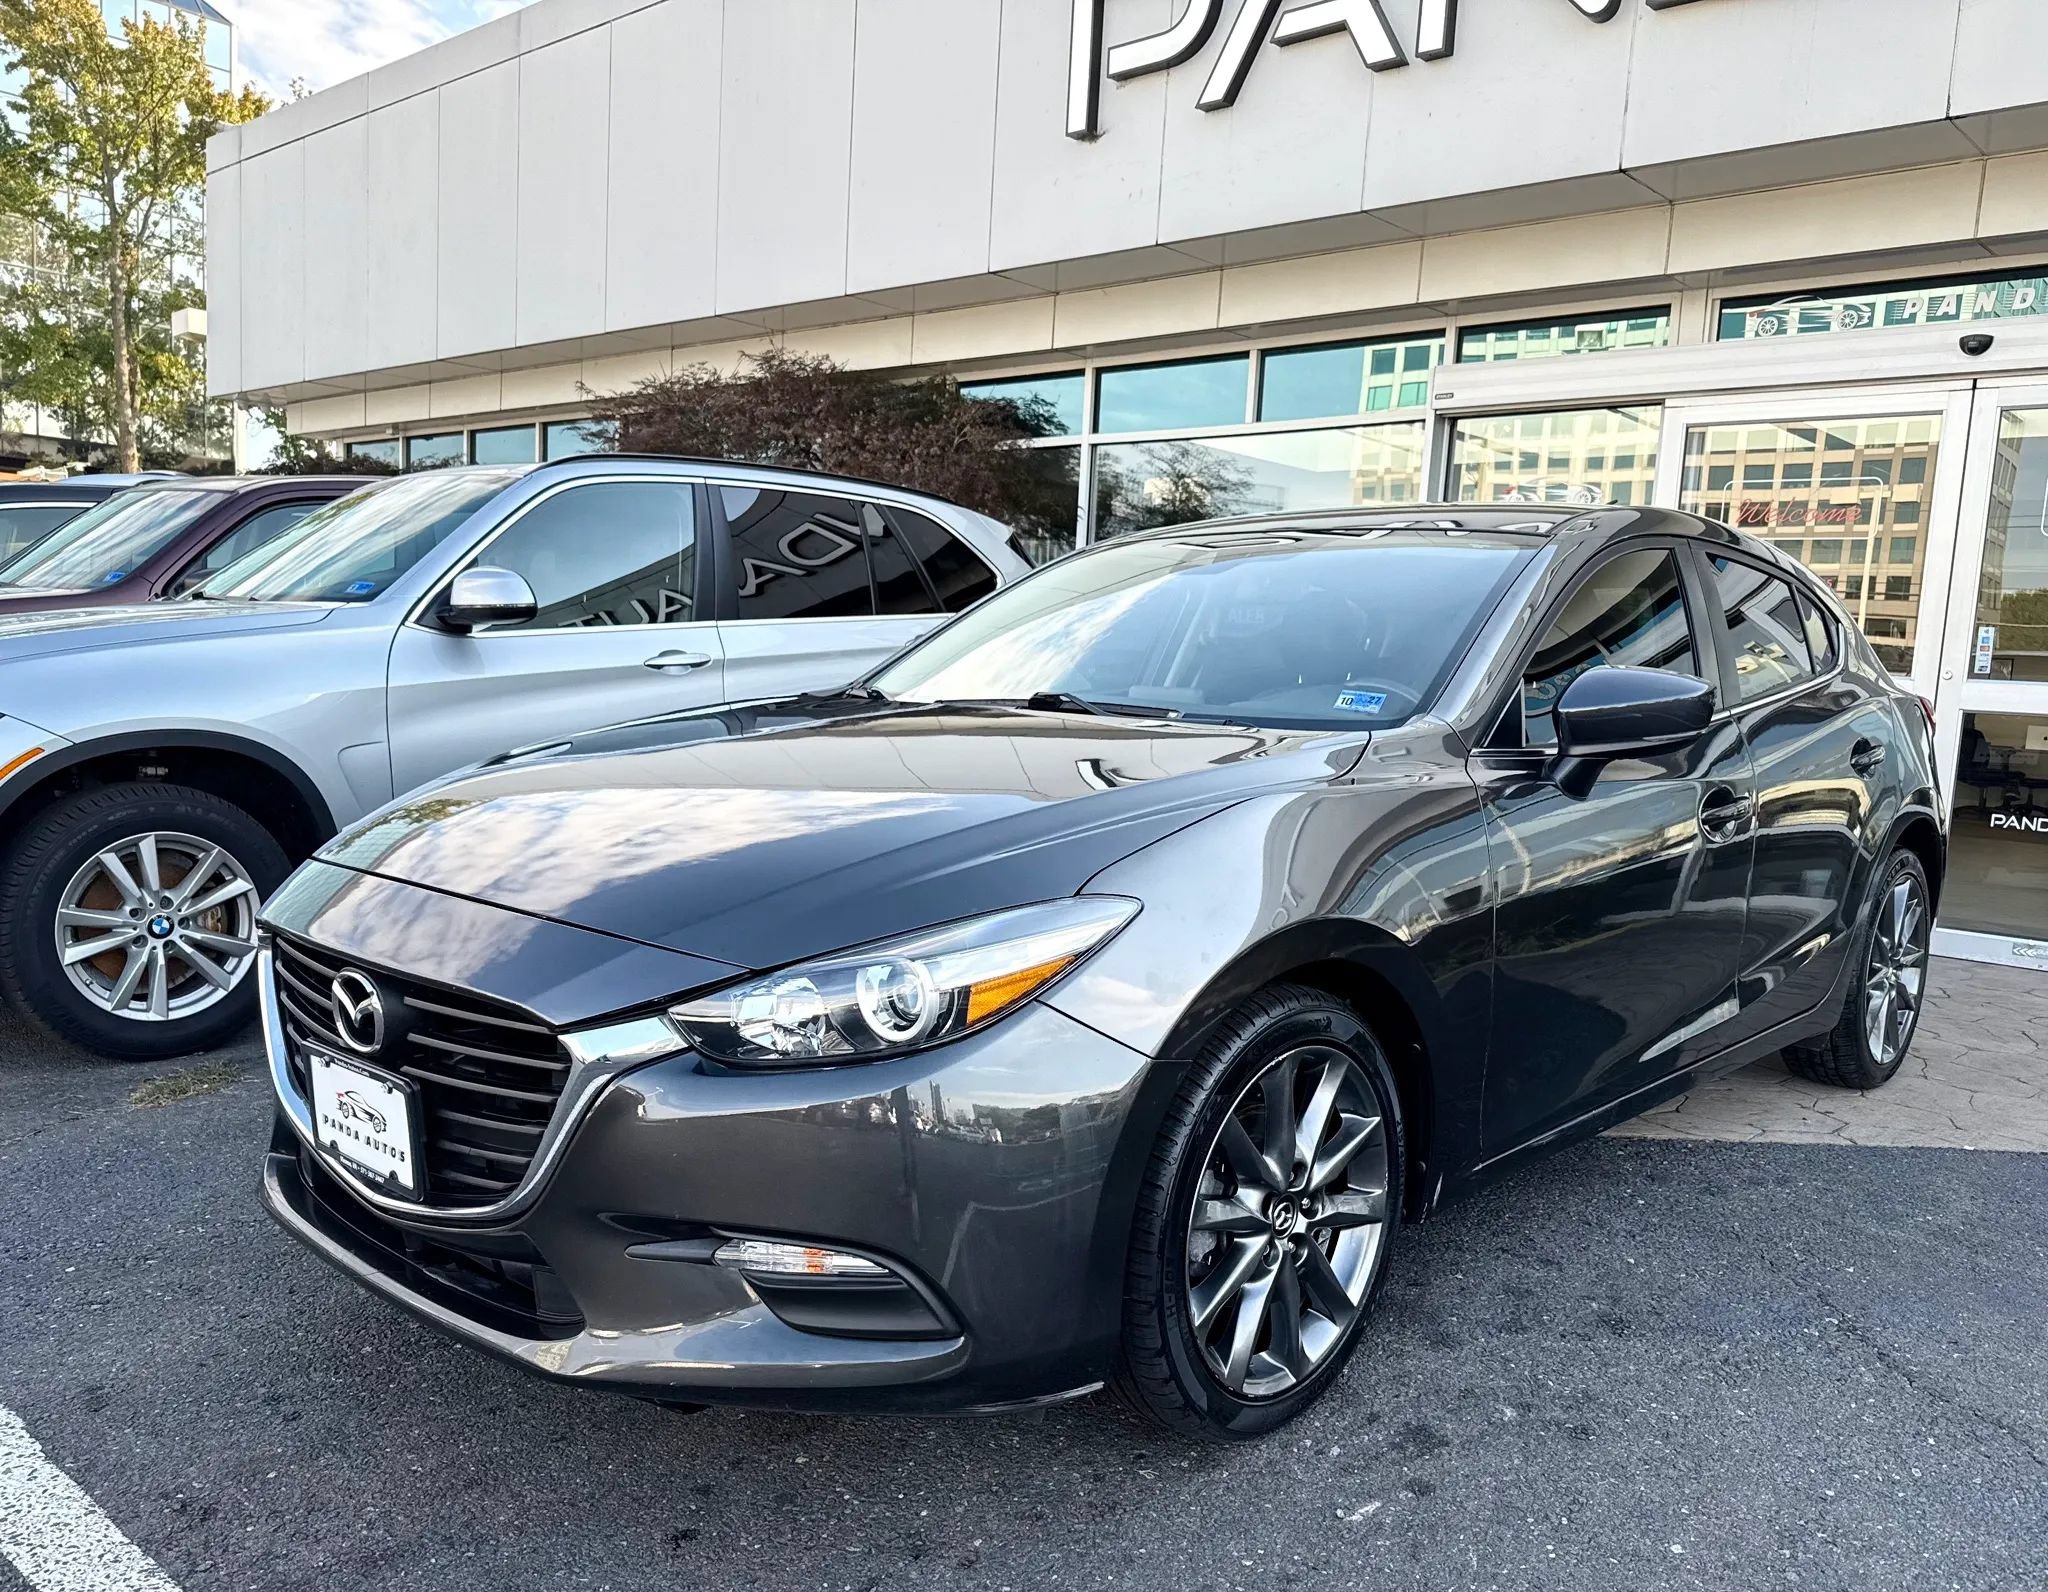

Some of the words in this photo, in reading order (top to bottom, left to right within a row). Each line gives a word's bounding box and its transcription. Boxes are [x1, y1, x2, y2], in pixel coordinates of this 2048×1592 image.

[1736, 496, 1862, 526] Welcome
[1340, 696, 1354, 706] 10
[322, 1113, 360, 1141] PANDA
[364, 1135, 405, 1162] AUTOS
